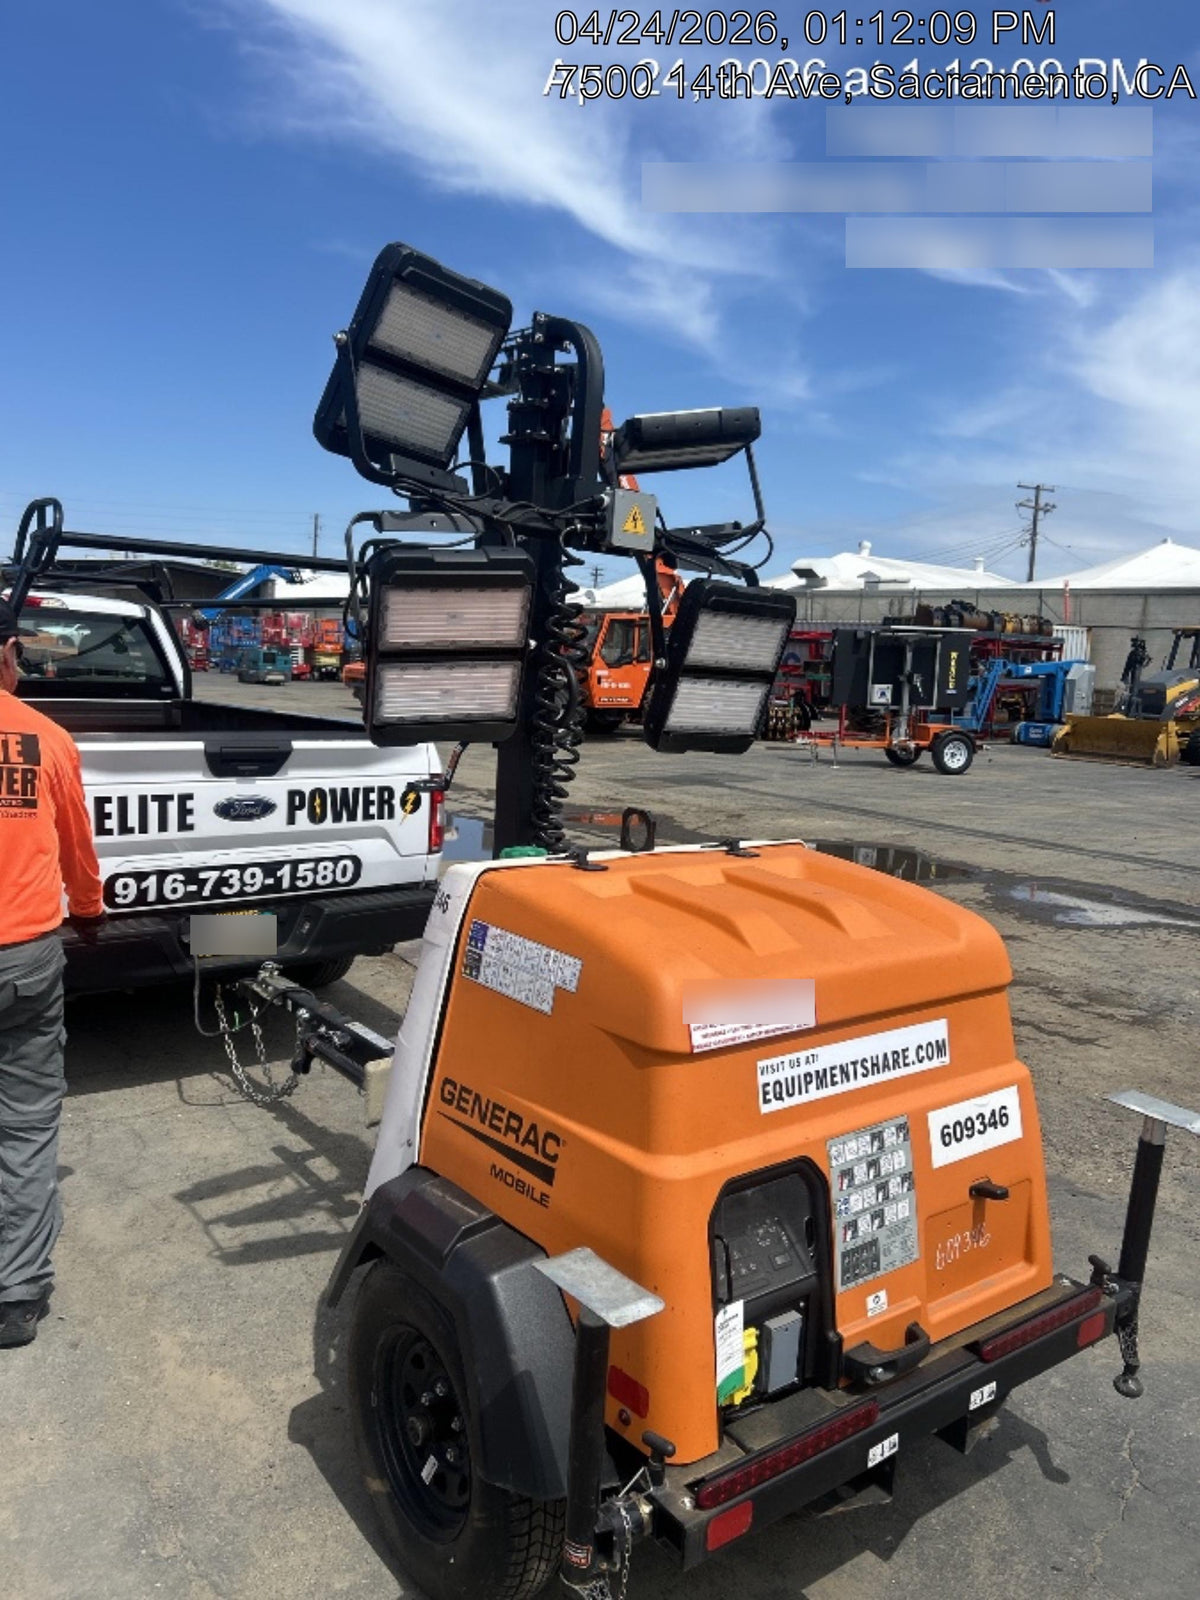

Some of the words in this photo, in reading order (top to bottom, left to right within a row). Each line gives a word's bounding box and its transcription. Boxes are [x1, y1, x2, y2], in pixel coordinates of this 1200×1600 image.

[94, 793, 195, 836] ELITE
[287, 786, 395, 826] POWER
[114, 859, 355, 903] 916-739-1580
[759, 1060, 785, 1076] VISIT
[789, 1058, 801, 1070] US
[762, 1038, 947, 1105] EQUIPMENTSHARE.COM
[440, 1077, 561, 1163] GENERAC
[940, 1105, 1009, 1148] 609346
[490, 1163, 551, 1208] MOBILE
